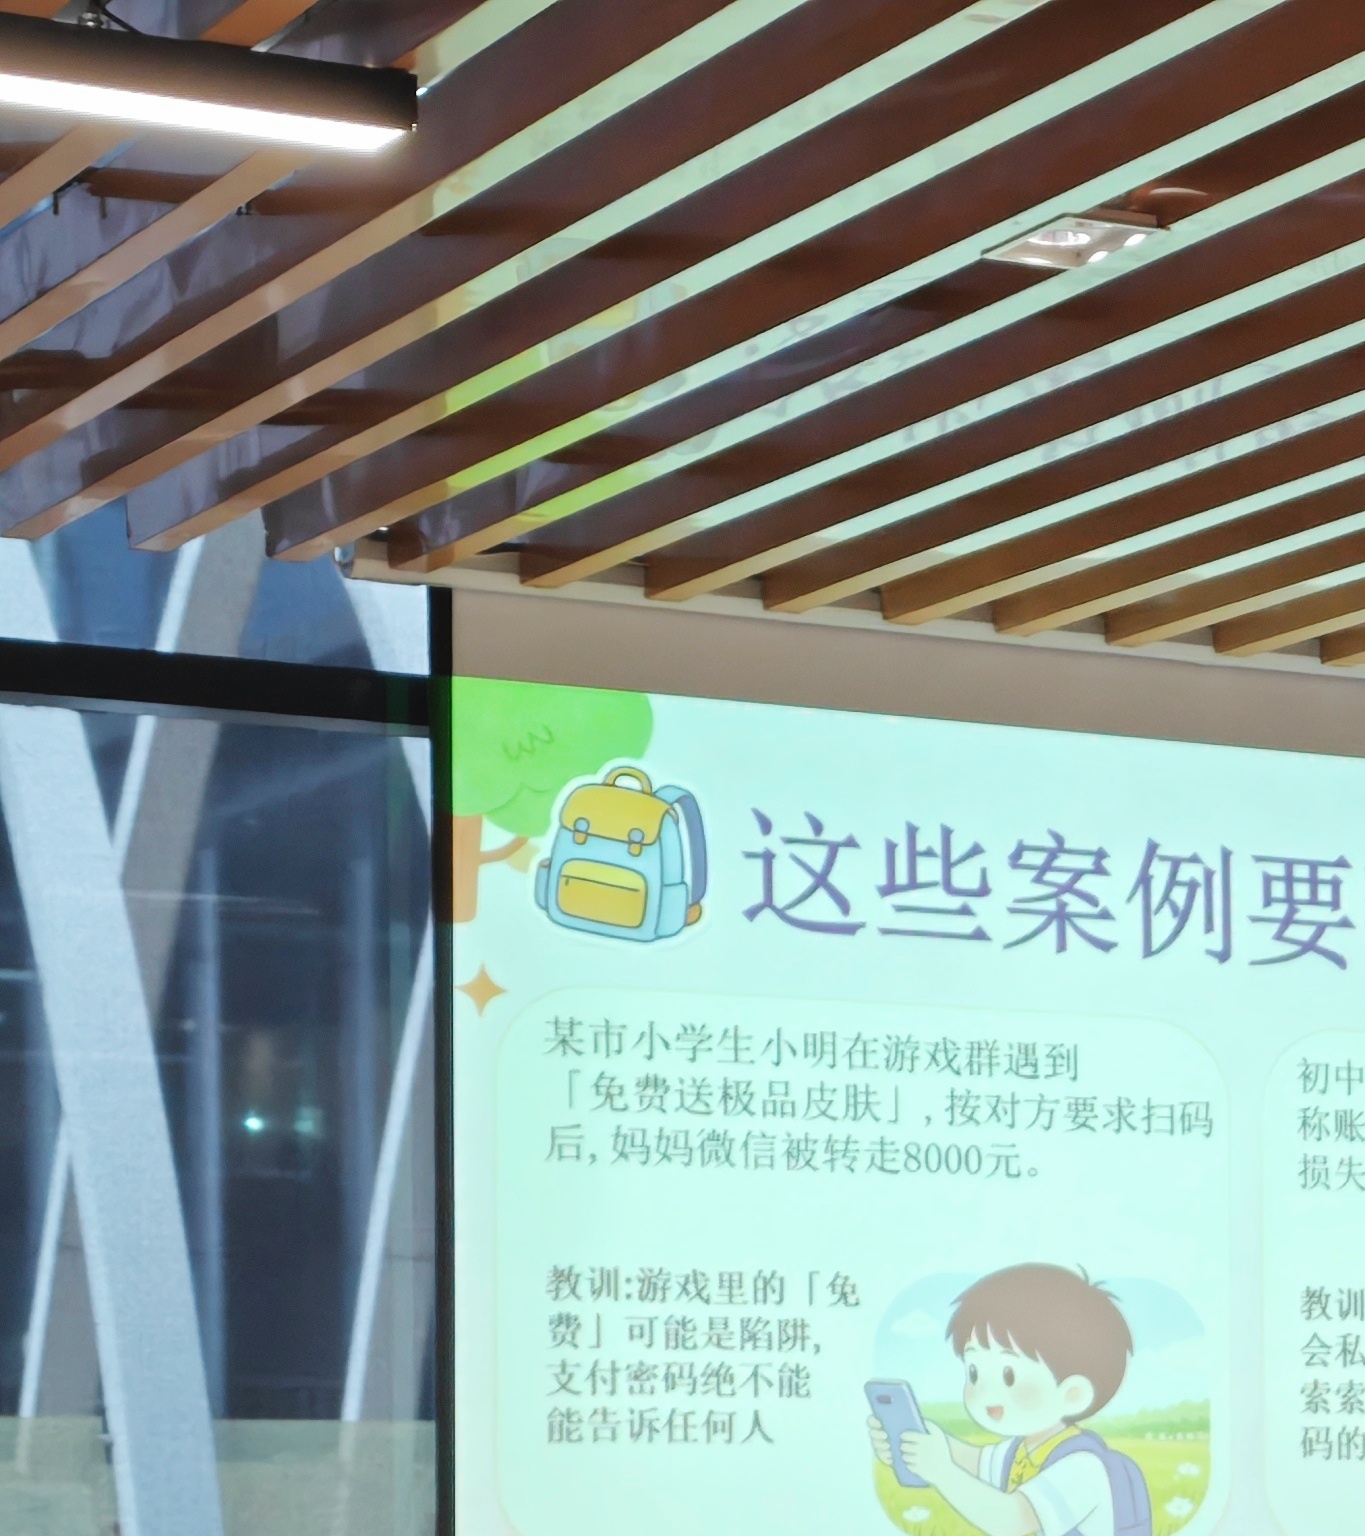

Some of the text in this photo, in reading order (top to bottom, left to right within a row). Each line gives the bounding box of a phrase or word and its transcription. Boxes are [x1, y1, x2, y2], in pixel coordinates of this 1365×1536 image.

[543, 1016, 1080, 1083] 某市小学生小明在游戏群遇到
[546, 1263, 861, 1308] 教训:游戏里的「免
[546, 1359, 812, 1401] 支付密码绝不能
[546, 1405, 775, 1447] 能告诉任何人
